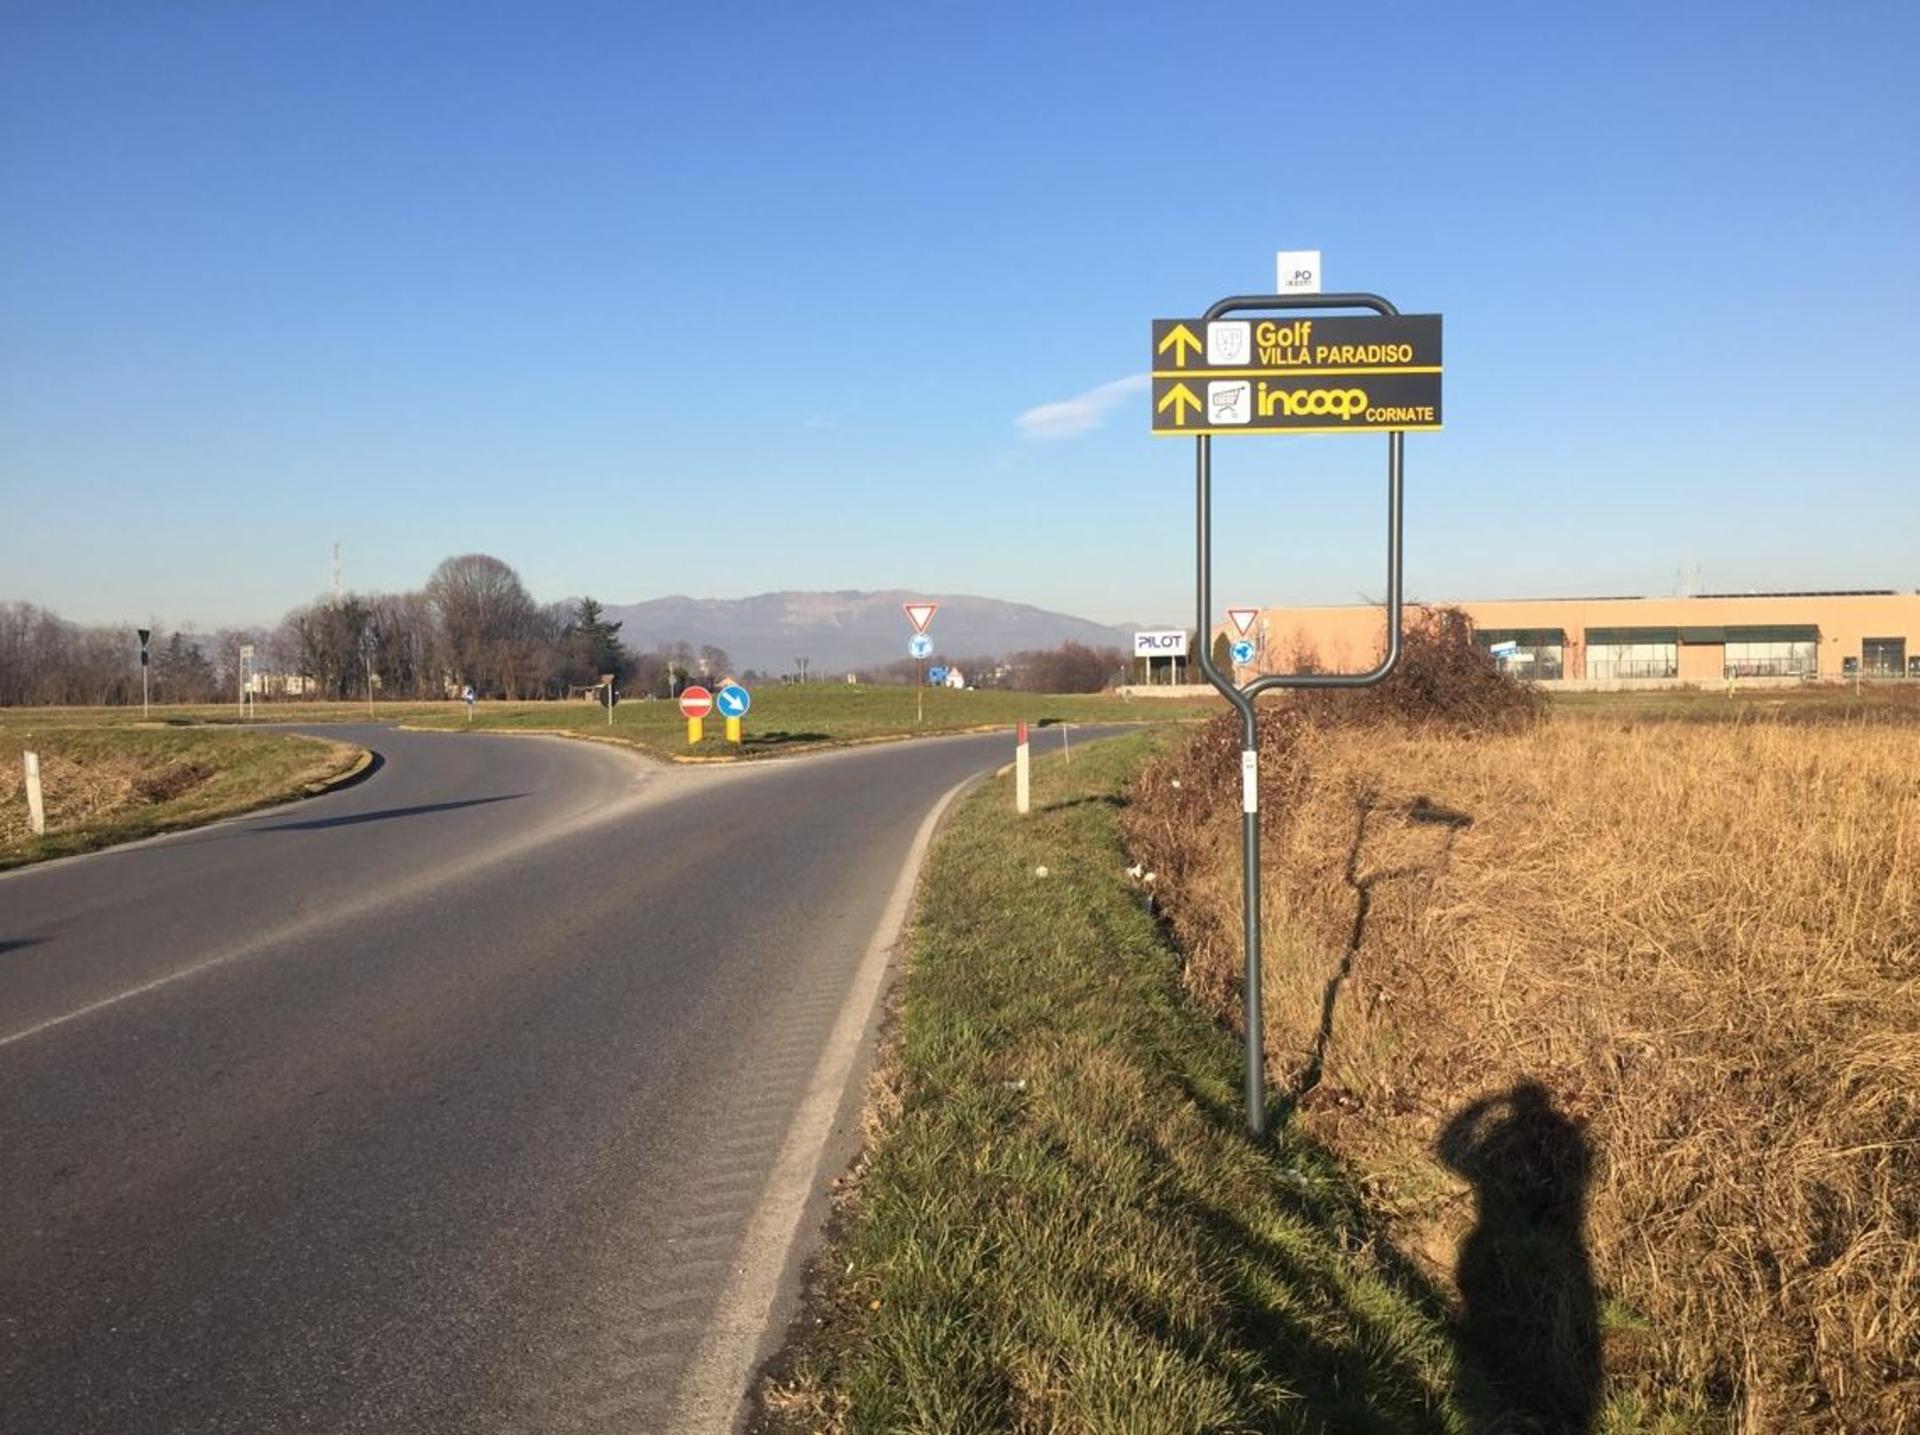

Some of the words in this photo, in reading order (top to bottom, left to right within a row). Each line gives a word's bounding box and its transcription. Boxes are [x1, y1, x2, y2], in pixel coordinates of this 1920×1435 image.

[1256, 321, 1312, 348] Golf
[1258, 348, 1311, 365] VILLA
[1316, 345, 1413, 364] PARADISO
[1257, 382, 1368, 420] incoop
[1365, 406, 1434, 421] CORNATE
[1138, 635, 1183, 649] PILOT
